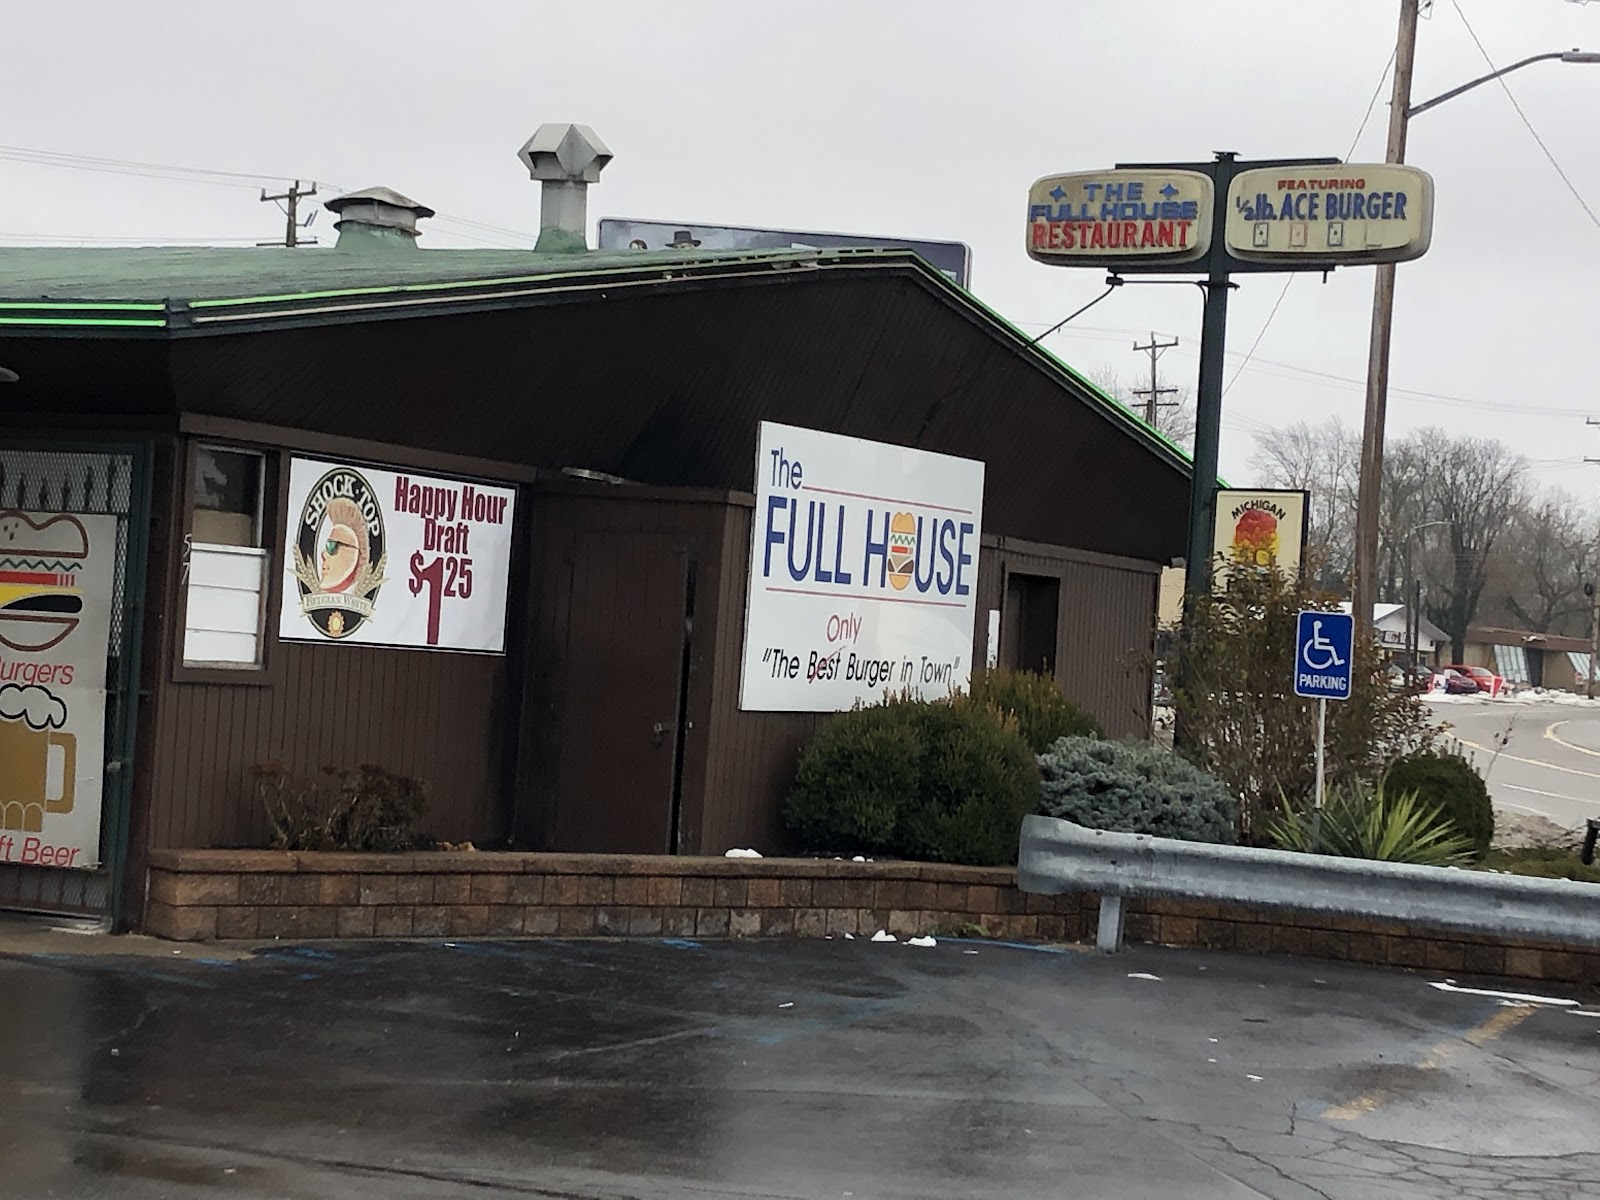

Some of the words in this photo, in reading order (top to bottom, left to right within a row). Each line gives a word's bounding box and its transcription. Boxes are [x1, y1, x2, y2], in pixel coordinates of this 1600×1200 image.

[1083, 182, 1145, 202] THE
[1277, 178, 1366, 190] FEATURING
[1030, 203, 1096, 222] FULL
[1101, 201, 1199, 221] HOUSE
[1279, 192, 1320, 221] ACE
[1325, 192, 1408, 220] BURGER
[1031, 221, 1193, 249] RESTAURANT
[770, 447, 803, 490] The
[394, 476, 458, 522] Happy
[461, 485, 508, 525] Hour
[1231, 499, 1287, 520] MICHIGAN
[423, 518, 470, 555] Draft
[763, 495, 852, 585] FULL
[826, 612, 863, 644] Only
[0, 656, 75, 685] urgers
[807, 651, 841, 680] Best
[846, 653, 896, 688] Burger
[900, 655, 913, 683] in
[1299, 673, 1347, 691] PARKING
[21, 837, 81, 868] Beer
